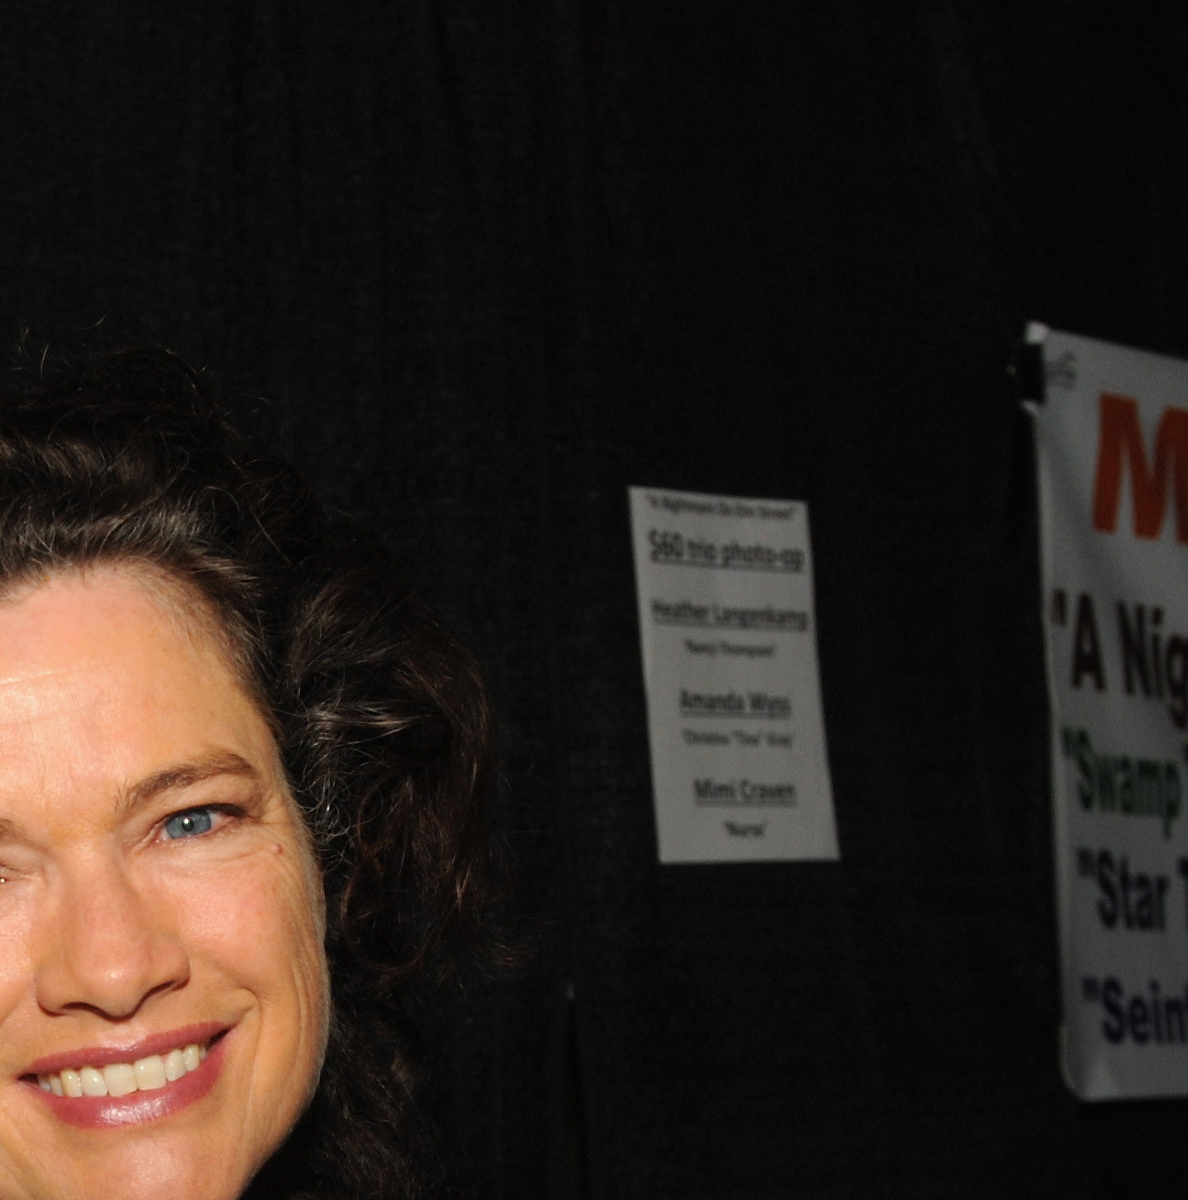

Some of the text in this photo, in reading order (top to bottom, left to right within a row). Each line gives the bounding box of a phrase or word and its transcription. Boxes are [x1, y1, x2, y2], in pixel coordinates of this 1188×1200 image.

[648, 528, 684, 562] $60
[720, 540, 804, 573] photo-op
[651, 598, 709, 620] Heather
[1052, 588, 1107, 693] "A
[679, 688, 745, 710] Amanda
[693, 776, 795, 800] Mimi Craven
[1062, 726, 1182, 840] "Swamp
[1077, 846, 1170, 932] "Star
